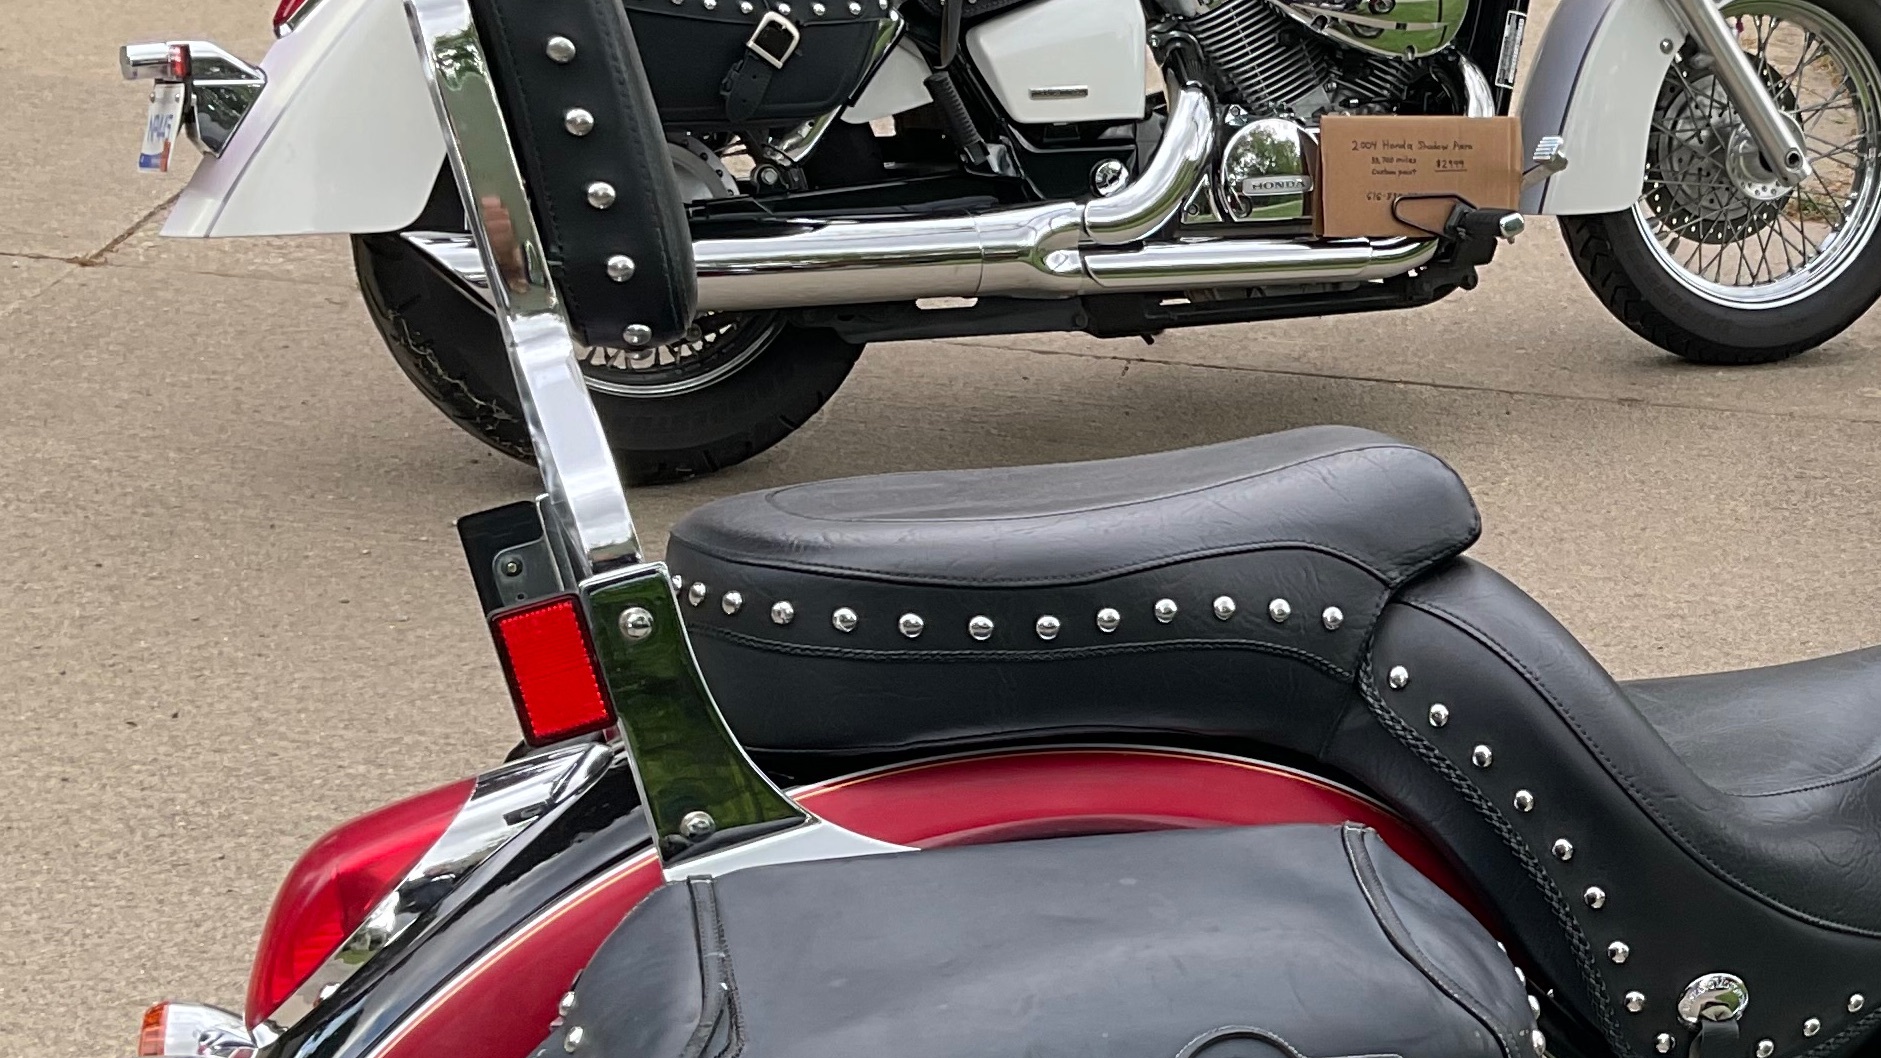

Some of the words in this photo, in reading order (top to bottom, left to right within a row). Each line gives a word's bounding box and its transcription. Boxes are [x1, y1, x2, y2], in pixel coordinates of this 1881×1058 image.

[1351, 140, 1377, 151] 2004
[1382, 139, 1413, 151] Honda
[1418, 140, 1449, 152] Shadow
[1252, 179, 1306, 190] HONDA
